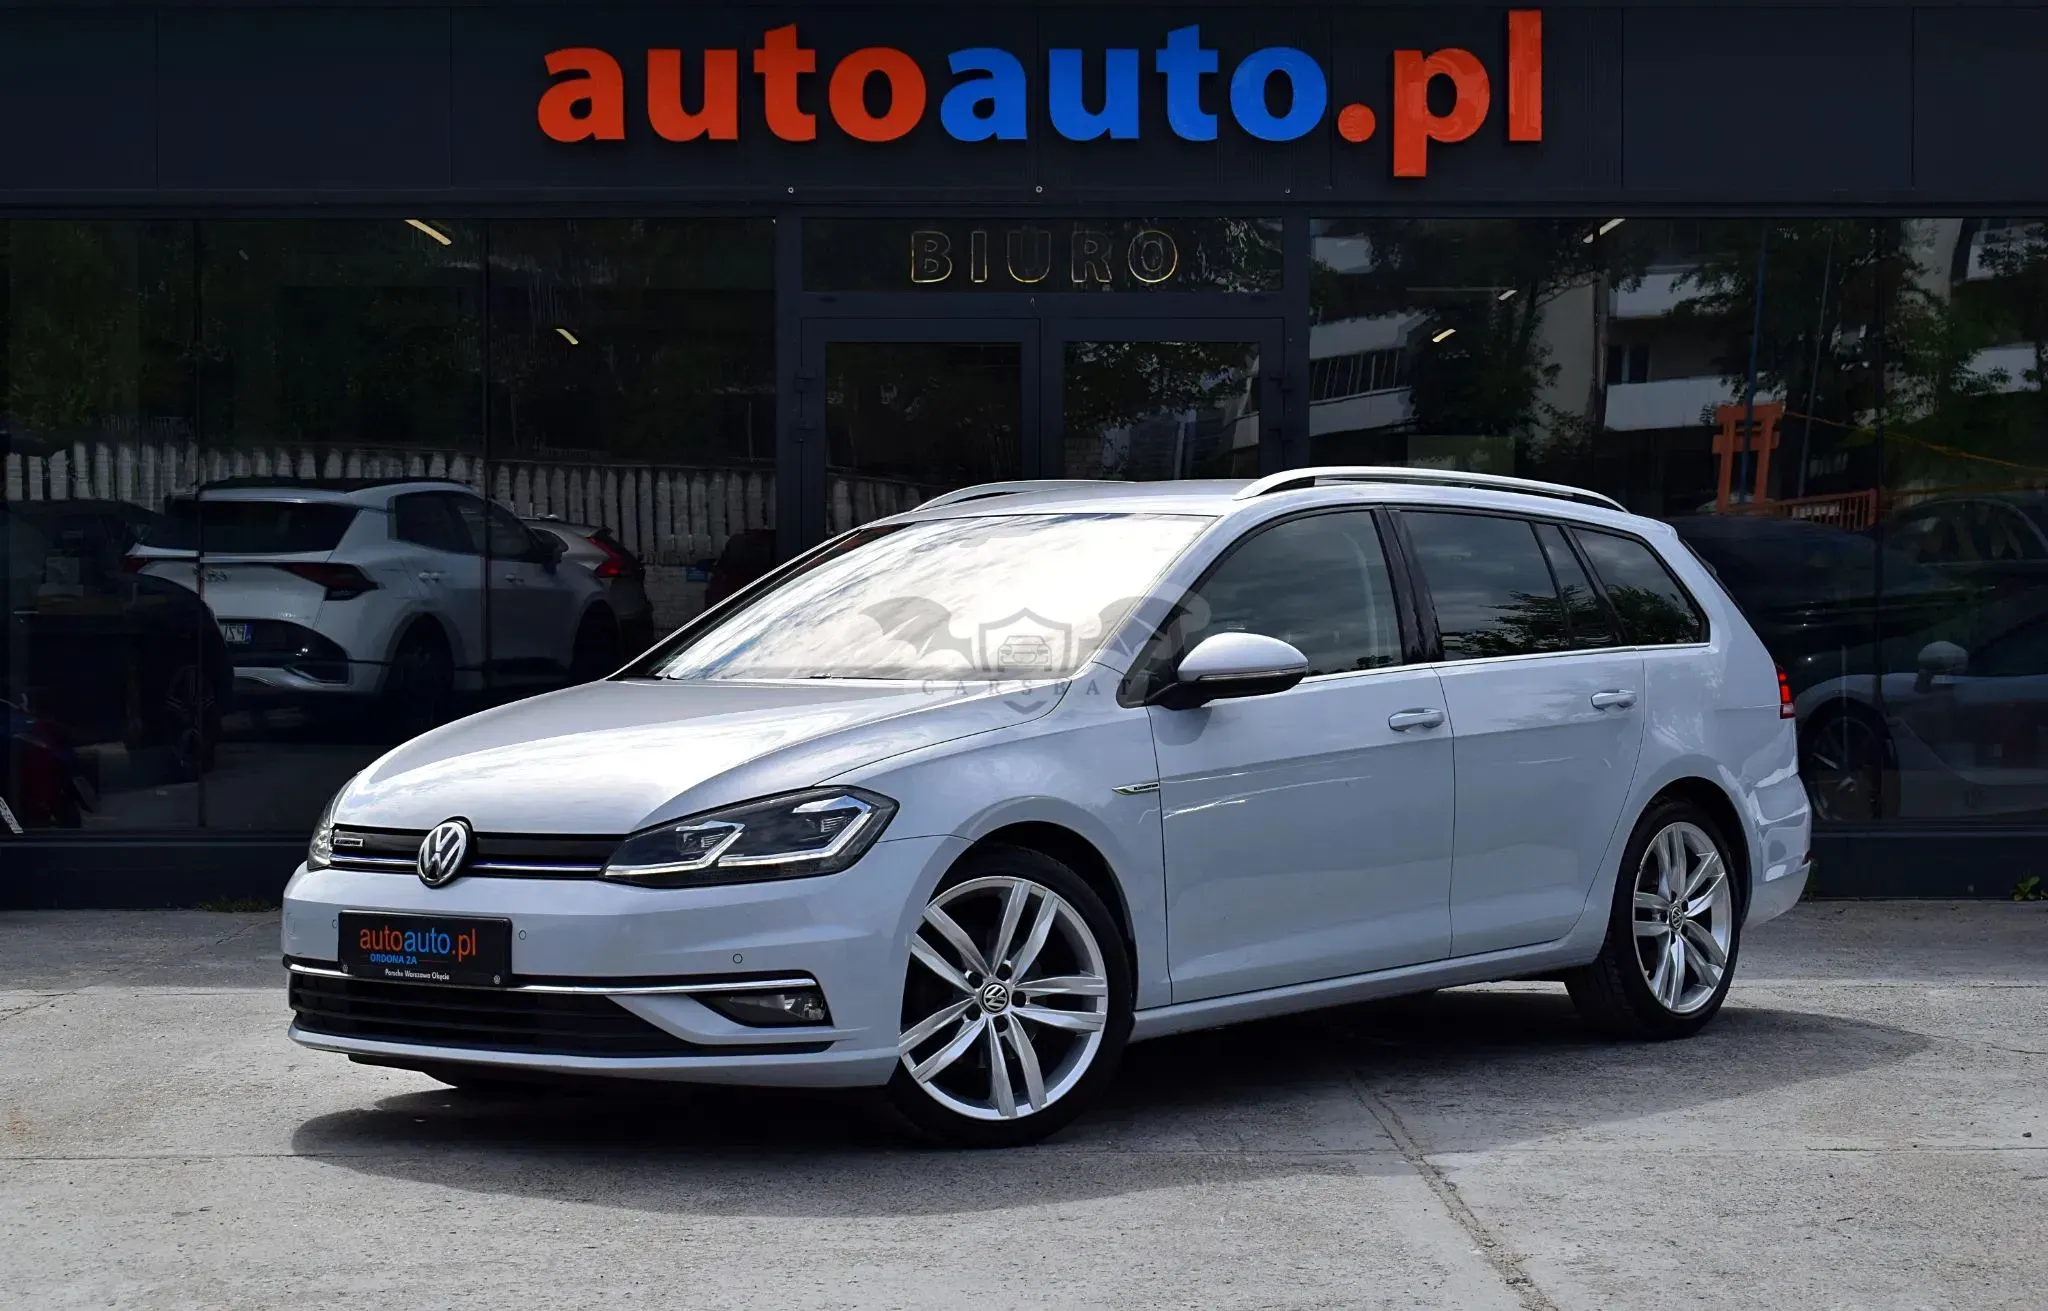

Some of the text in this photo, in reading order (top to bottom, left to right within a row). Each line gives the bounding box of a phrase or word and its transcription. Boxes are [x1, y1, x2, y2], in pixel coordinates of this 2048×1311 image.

[537, 9, 1542, 177] autoauto.pl
[910, 229, 1178, 283] BIURO
[359, 924, 477, 962] autoauto.pl
